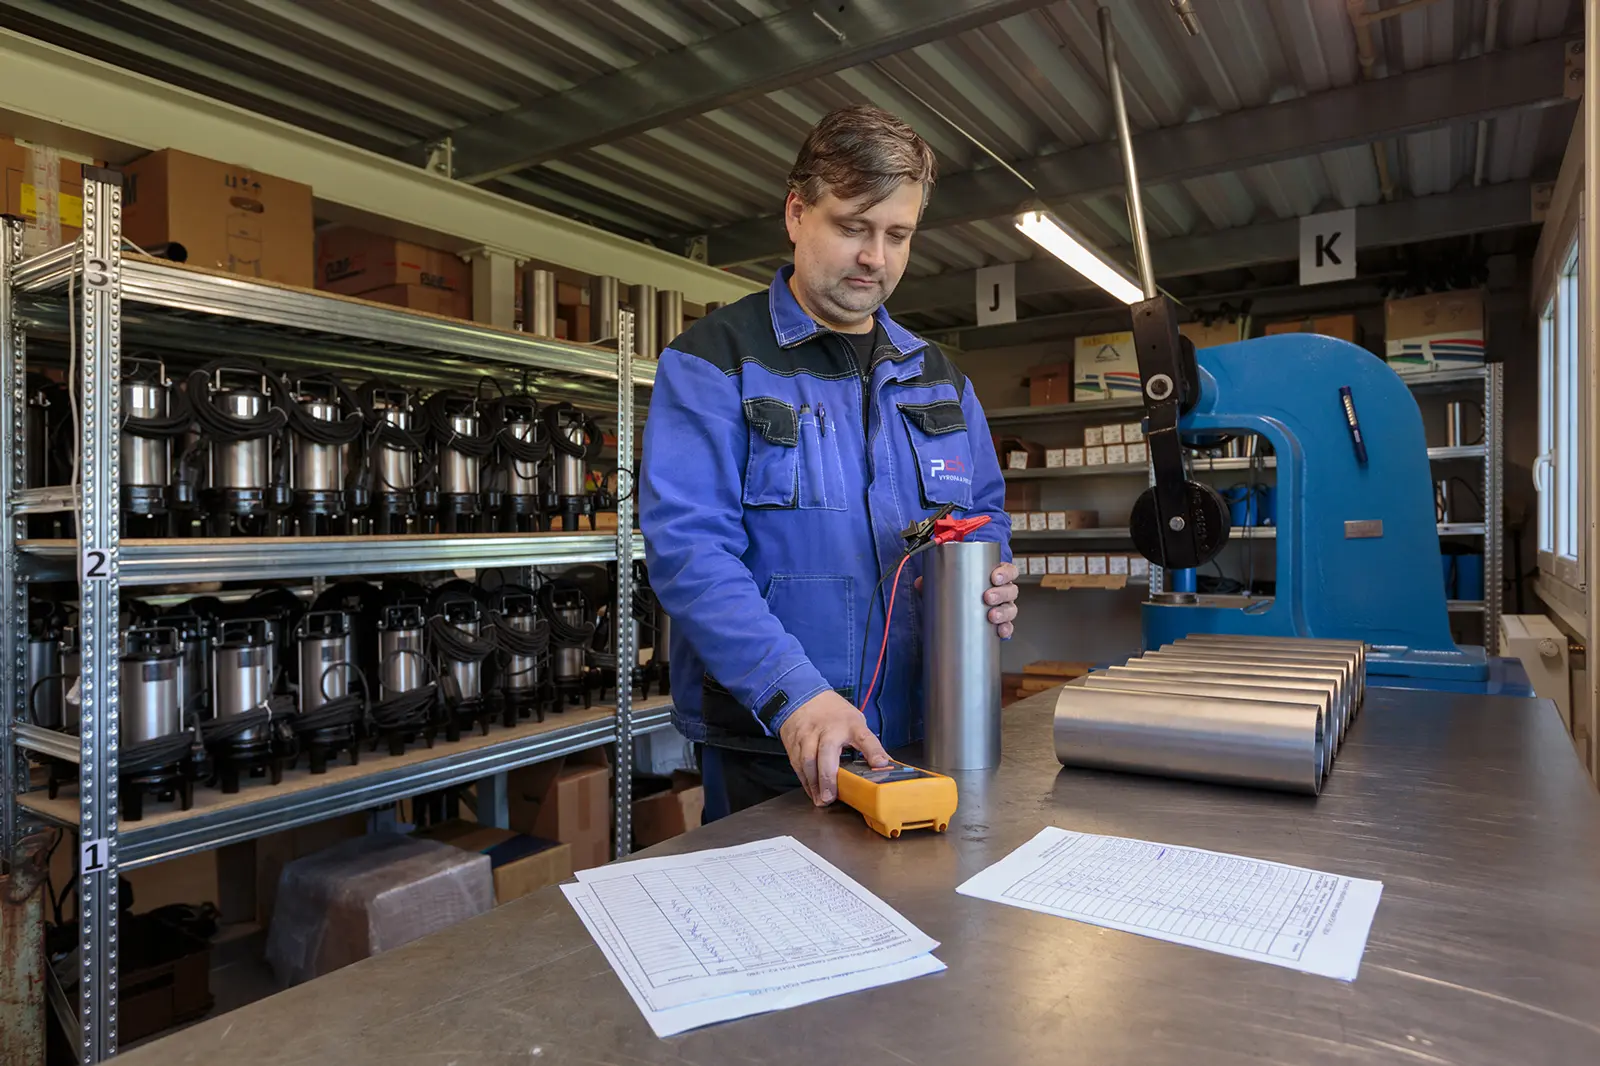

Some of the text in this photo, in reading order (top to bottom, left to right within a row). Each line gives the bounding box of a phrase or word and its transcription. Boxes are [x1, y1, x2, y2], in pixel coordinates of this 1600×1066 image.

[1315, 231, 1342, 268] K
[88, 259, 109, 287] 3
[989, 283, 1000, 312] J
[86, 551, 107, 577] 2
[85, 843, 104, 871] 1
